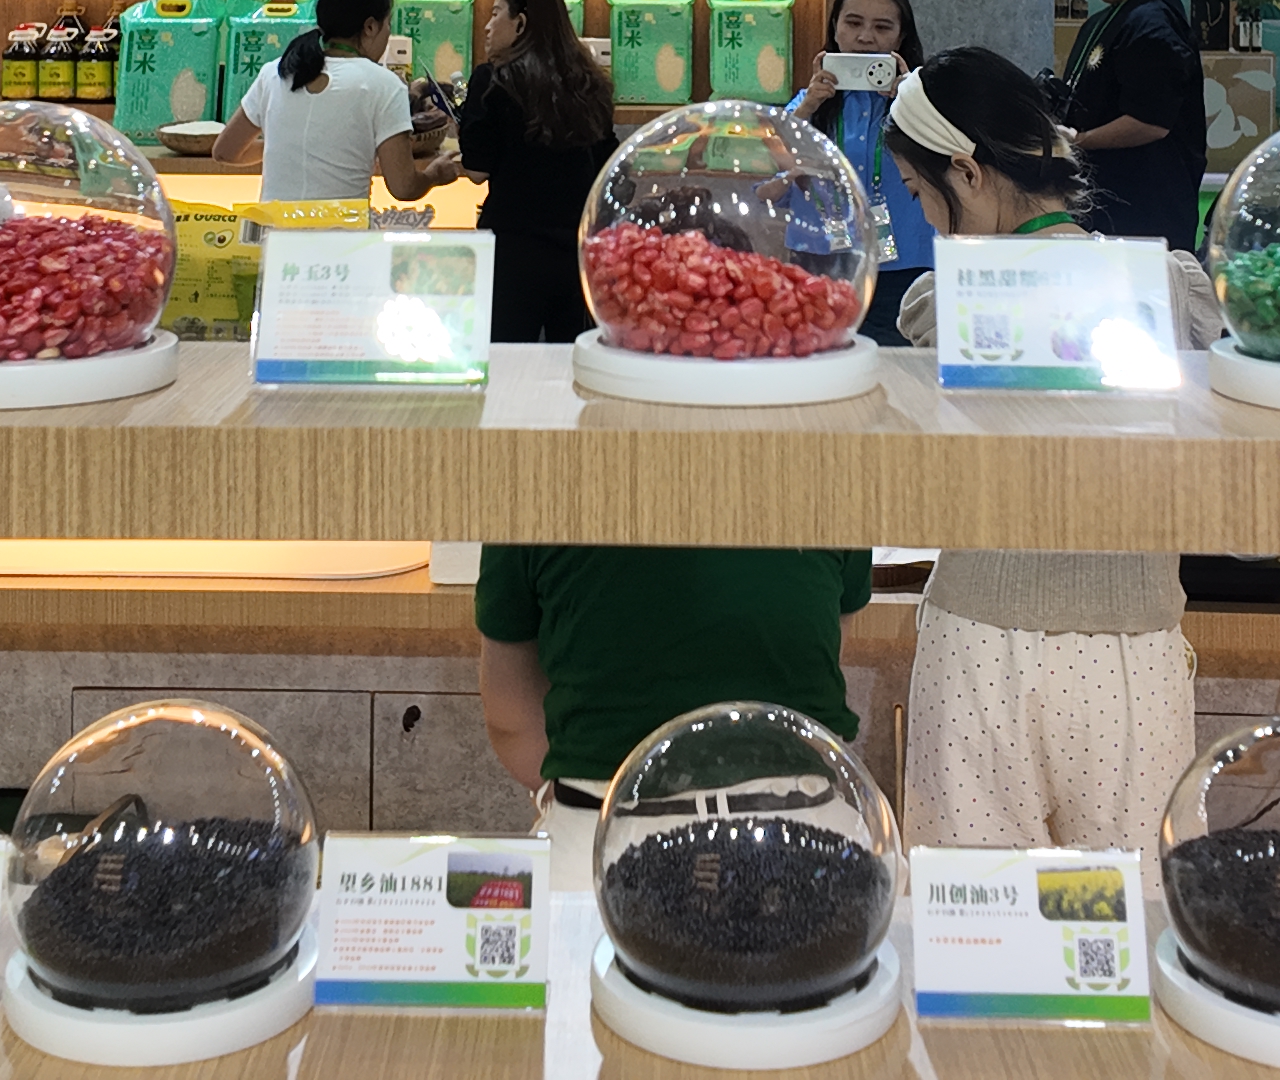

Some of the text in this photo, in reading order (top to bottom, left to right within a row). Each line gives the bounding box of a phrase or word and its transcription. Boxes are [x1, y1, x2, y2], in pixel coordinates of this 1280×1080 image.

[623, 9, 643, 49] 喜米
[723, 10, 743, 50] 喜米
[133, 27, 159, 75] 喜米
[338, 871, 443, 895] 望乡油1881
[928, 882, 1020, 906] 川创油3号
